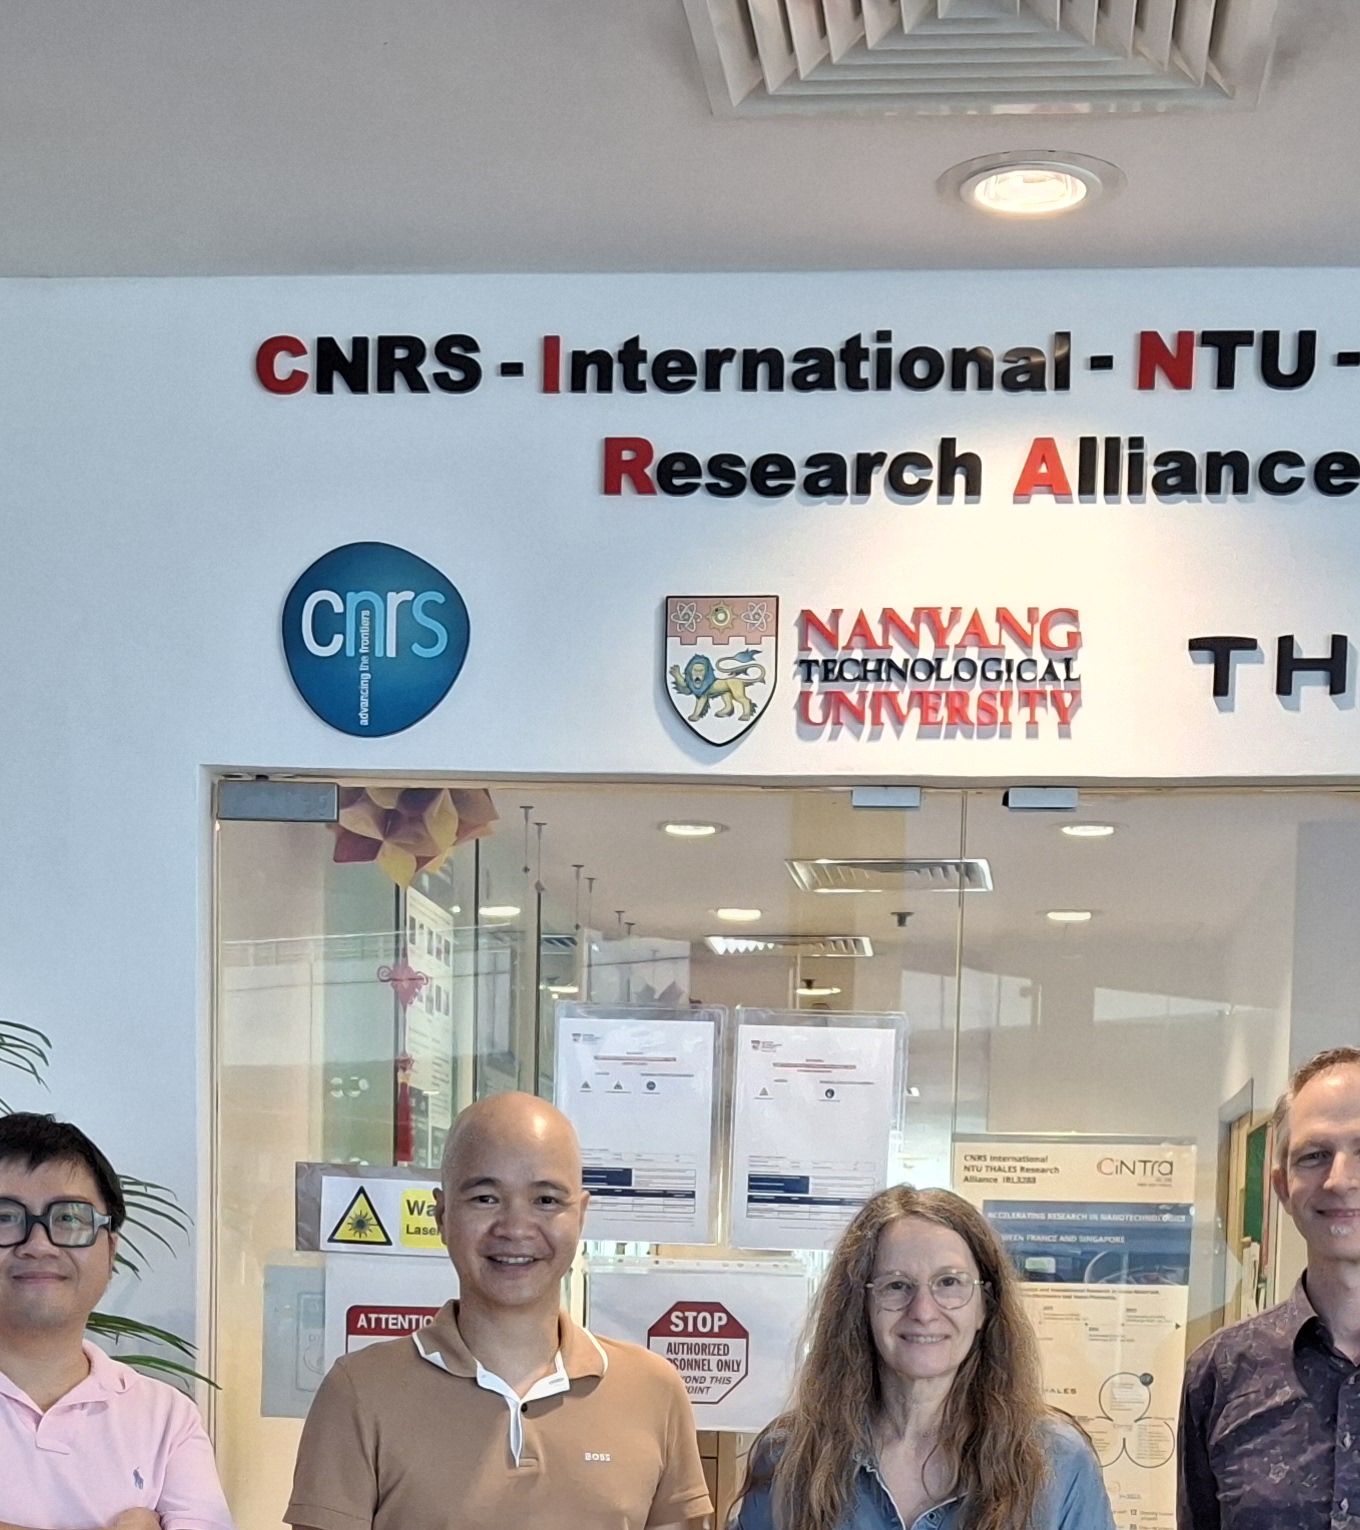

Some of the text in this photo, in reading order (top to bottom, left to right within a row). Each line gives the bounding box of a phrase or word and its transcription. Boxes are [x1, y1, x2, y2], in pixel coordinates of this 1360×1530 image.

[256, 334, 482, 394] CNRS
[542, 329, 1071, 394] International
[1137, 330, 1317, 390] NTU
[602, 436, 981, 497] Research
[301, 590, 448, 658] cnrs
[798, 607, 1082, 652] NANYANG
[358, 610, 371, 726] advancing the frontiers
[798, 657, 1080, 684] TECHNOLOGICAL
[798, 690, 1080, 727] UNIVERSITY
[963, 1154, 1049, 1163] CNRS International
[963, 1165, 1060, 1175] NTU THALES Research
[963, 1176, 998, 1184] Alliance
[357, 1313, 434, 1329] ATTENTIO
[670, 1311, 728, 1333] STOP
[666, 1342, 730, 1356] AUTHORIZED
[716, 1359, 742, 1373] ONLY
[709, 1376, 732, 1385] THIS
[685, 1386, 711, 1395] OINT
